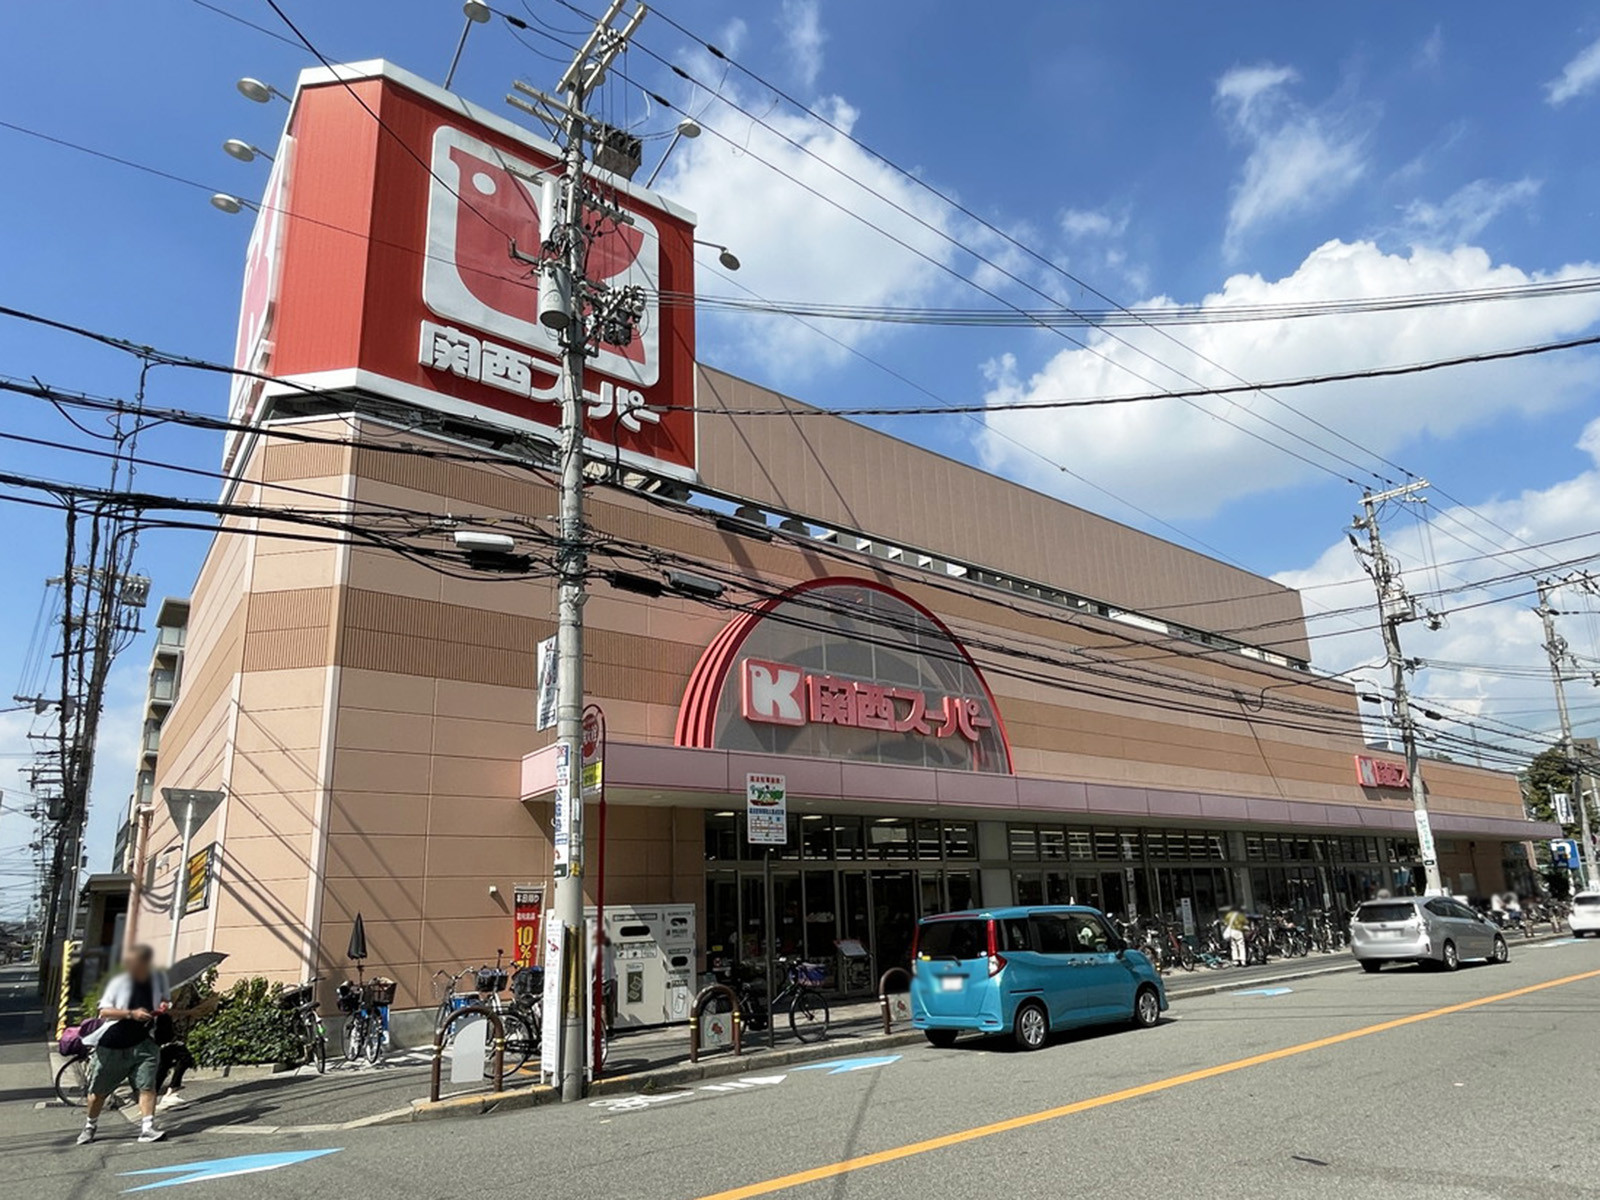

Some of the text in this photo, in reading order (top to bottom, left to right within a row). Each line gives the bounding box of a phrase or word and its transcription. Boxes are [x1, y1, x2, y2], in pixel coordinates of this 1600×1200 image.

[418, 319, 660, 433] 関西スーパー
[805, 674, 992, 742] 関西スーパー
[516, 926, 534, 946] 10
